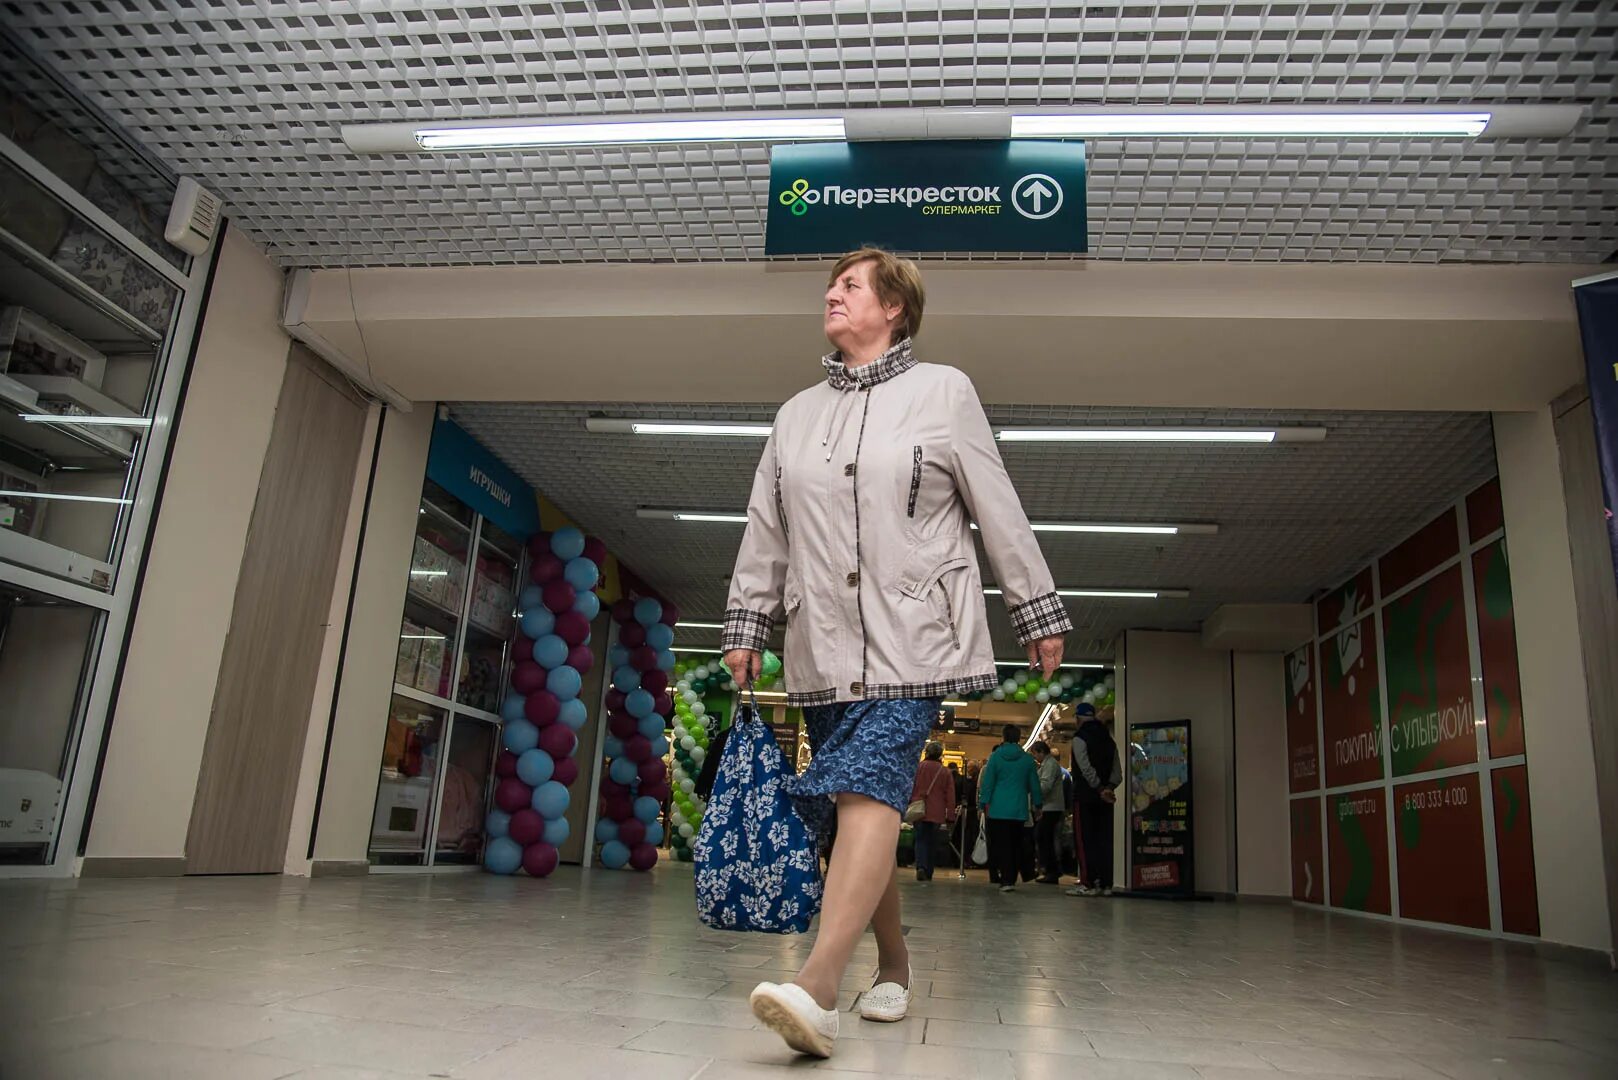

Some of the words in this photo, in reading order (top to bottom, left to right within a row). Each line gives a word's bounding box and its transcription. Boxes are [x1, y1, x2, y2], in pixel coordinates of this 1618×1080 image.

[823, 186, 1001, 208] Перекресток
[922, 205, 1002, 215] СУПЕРМАРКЕТ
[470, 465, 511, 507] ИГРУШКИ
[1335, 724, 1383, 766] ПОКУПАЙ
[1391, 724, 1400, 752] С
[1402, 697, 1474, 750] УЛЫБКОЙ!
[1405, 794, 1411, 810] 8
[1412, 792, 1426, 810] 800
[1427, 790, 1443, 808] 333
[1445, 788, 1450, 806] 4
[1452, 787, 1468, 805] 000
